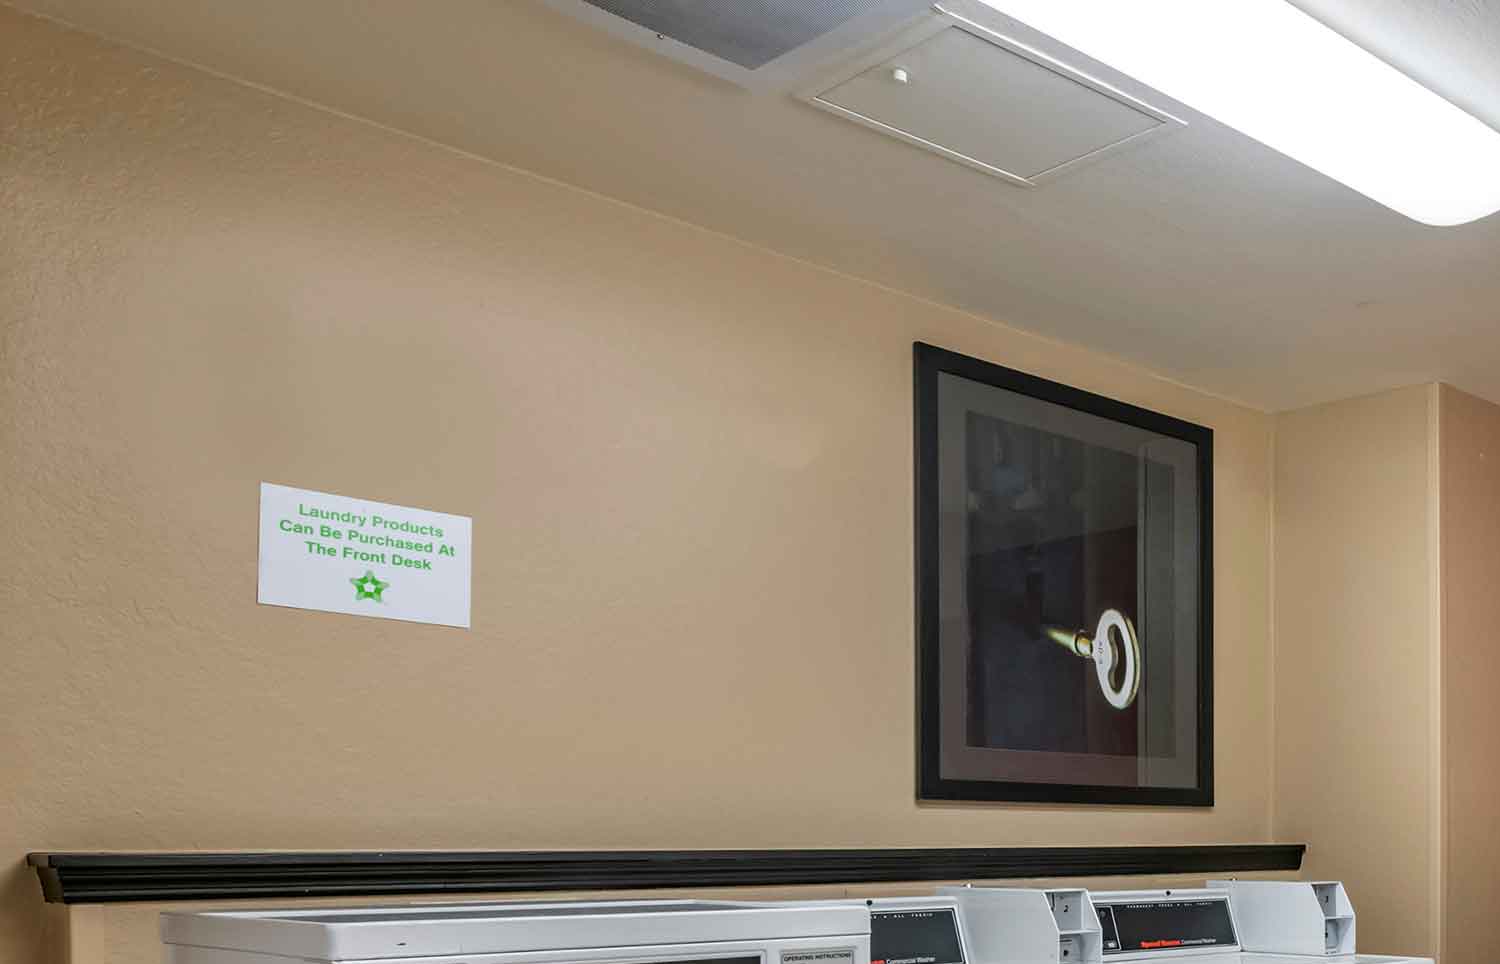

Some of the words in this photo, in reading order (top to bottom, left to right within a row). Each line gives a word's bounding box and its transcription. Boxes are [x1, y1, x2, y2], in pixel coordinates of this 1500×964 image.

[298, 503, 367, 527] Laundry
[372, 515, 444, 538] Products
[279, 519, 313, 535] Can
[320, 526, 342, 540] Be
[348, 529, 433, 553] Purchased
[438, 544, 455, 557] At
[304, 540, 337, 557] The
[343, 547, 387, 564] Front
[392, 554, 432, 570] Desk
[1063, 904, 1069, 913] 2
